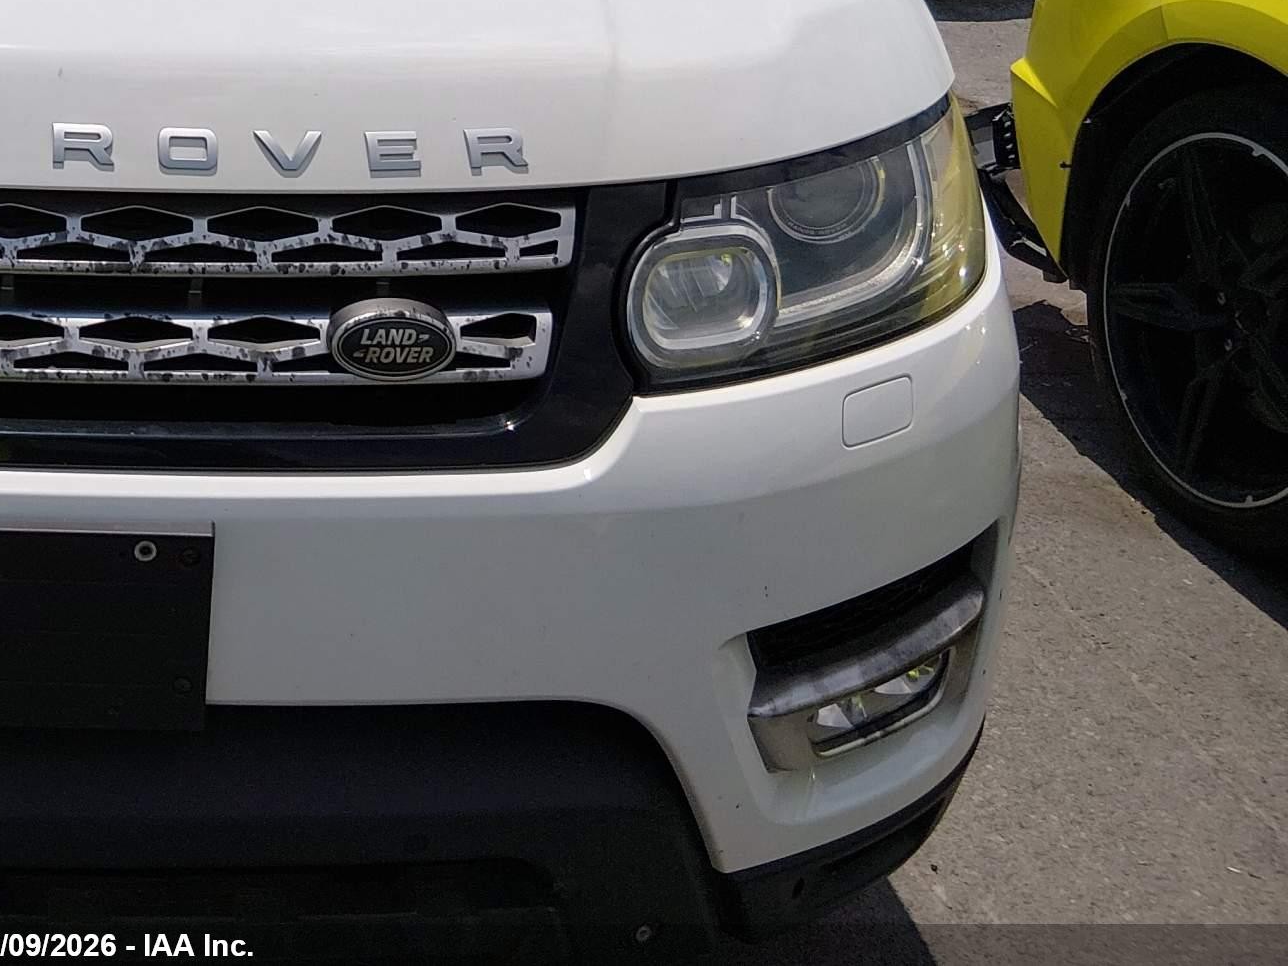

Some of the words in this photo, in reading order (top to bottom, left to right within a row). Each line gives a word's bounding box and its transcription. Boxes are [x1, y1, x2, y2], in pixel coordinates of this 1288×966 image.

[51, 121, 529, 178] ROVER
[360, 328, 417, 346] LAND
[365, 346, 434, 364] ROVER
